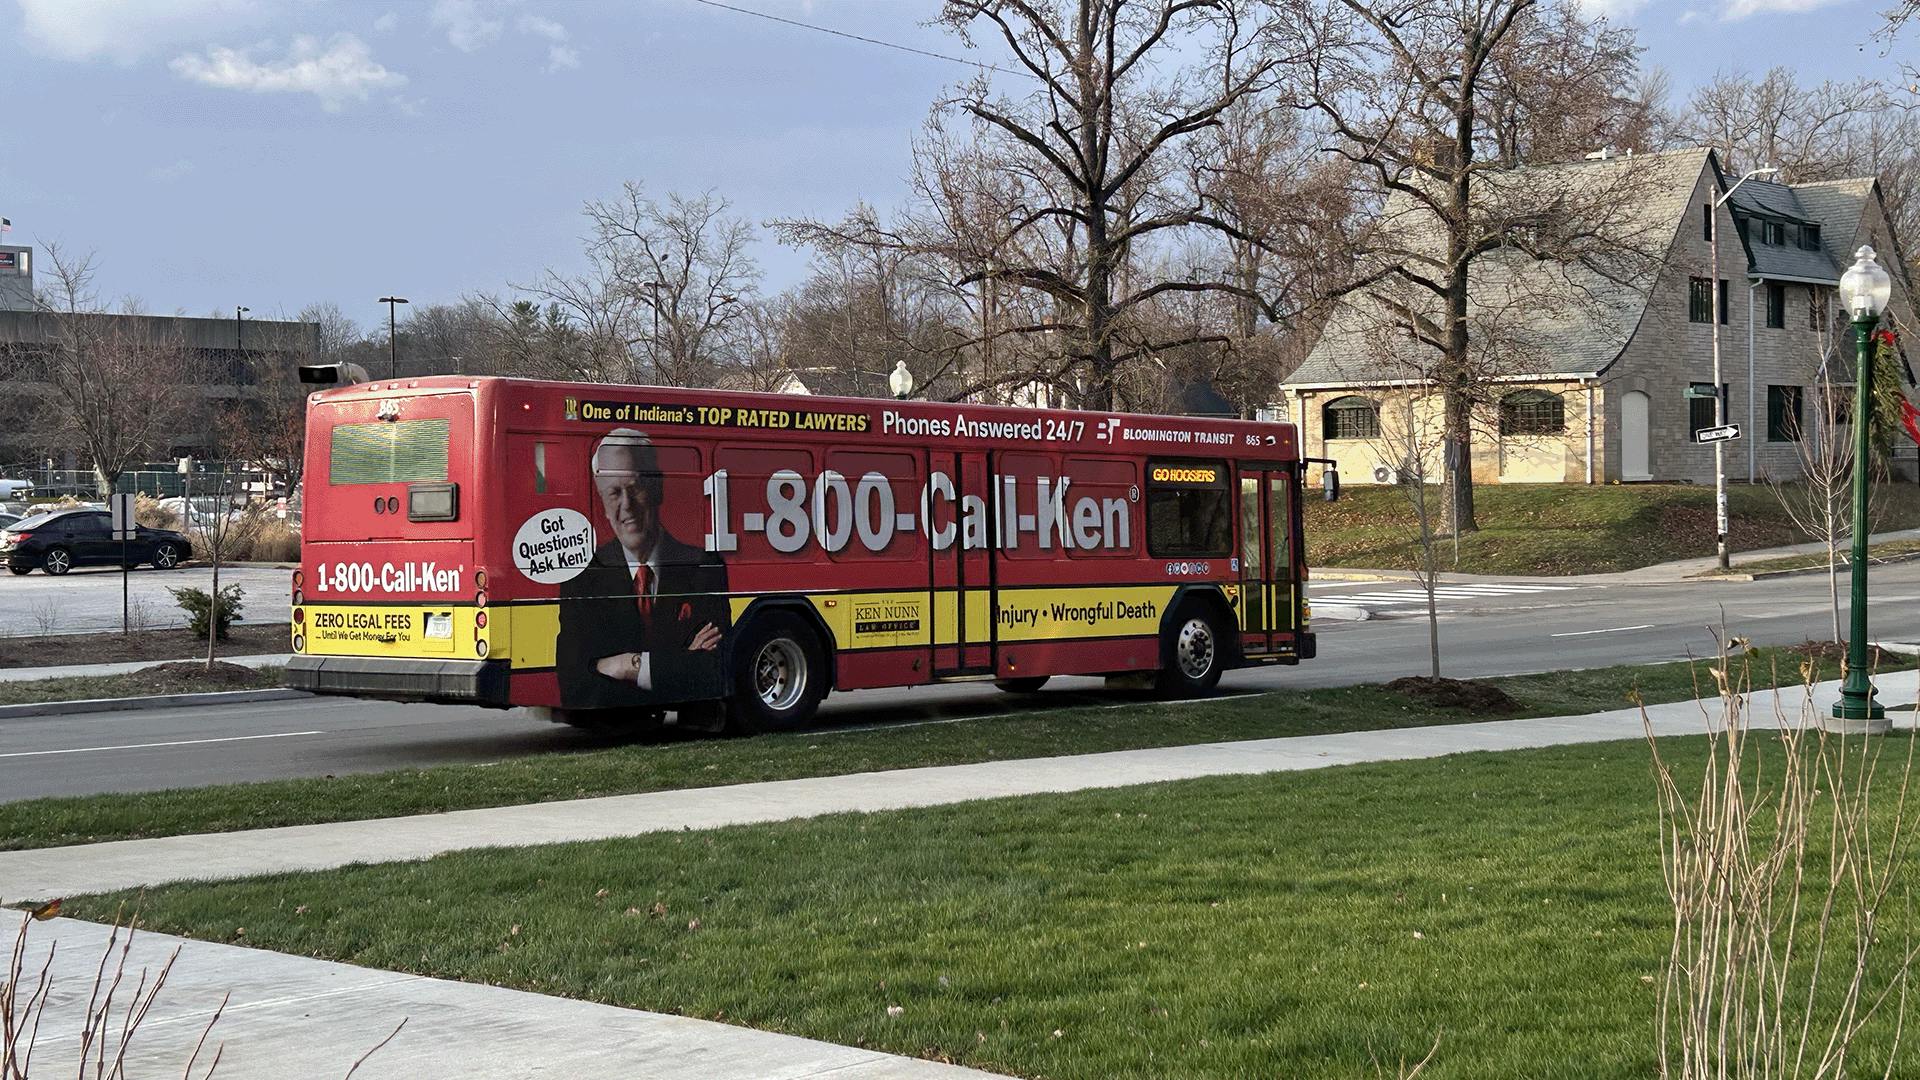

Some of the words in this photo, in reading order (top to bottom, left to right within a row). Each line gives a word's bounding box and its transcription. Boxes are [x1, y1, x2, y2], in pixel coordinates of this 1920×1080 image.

[582, 403, 612, 420] One
[615, 404, 631, 420] of
[634, 405, 694, 423] Indiana's
[697, 407, 732, 425] TOP
[736, 408, 790, 428] RATED
[882, 410, 950, 436] Phones
[954, 414, 1042, 440] Answered
[1046, 419, 1085, 442] 24/7
[1123, 428, 1191, 443] BLOOMINGTON
[1194, 432, 1234, 444] TRANSIT
[1152, 468, 1170, 481] GO
[541, 515, 565, 535] Got
[519, 527, 589, 560] Questions?
[529, 556, 555, 576] Ask
[557, 547, 588, 568] Ken!
[315, 613, 344, 628] ZERO
[346, 614, 382, 629] LEGAL
[384, 614, 411, 630] FEES
[855, 607, 881, 620] KEN
[885, 606, 919, 619] NUNN
[996, 604, 1039, 629] Injury
[1051, 602, 1113, 625] Wrongful
[1116, 600, 1156, 619] Death
[349, 631, 361, 641] Get
[398, 632, 411, 642] You
